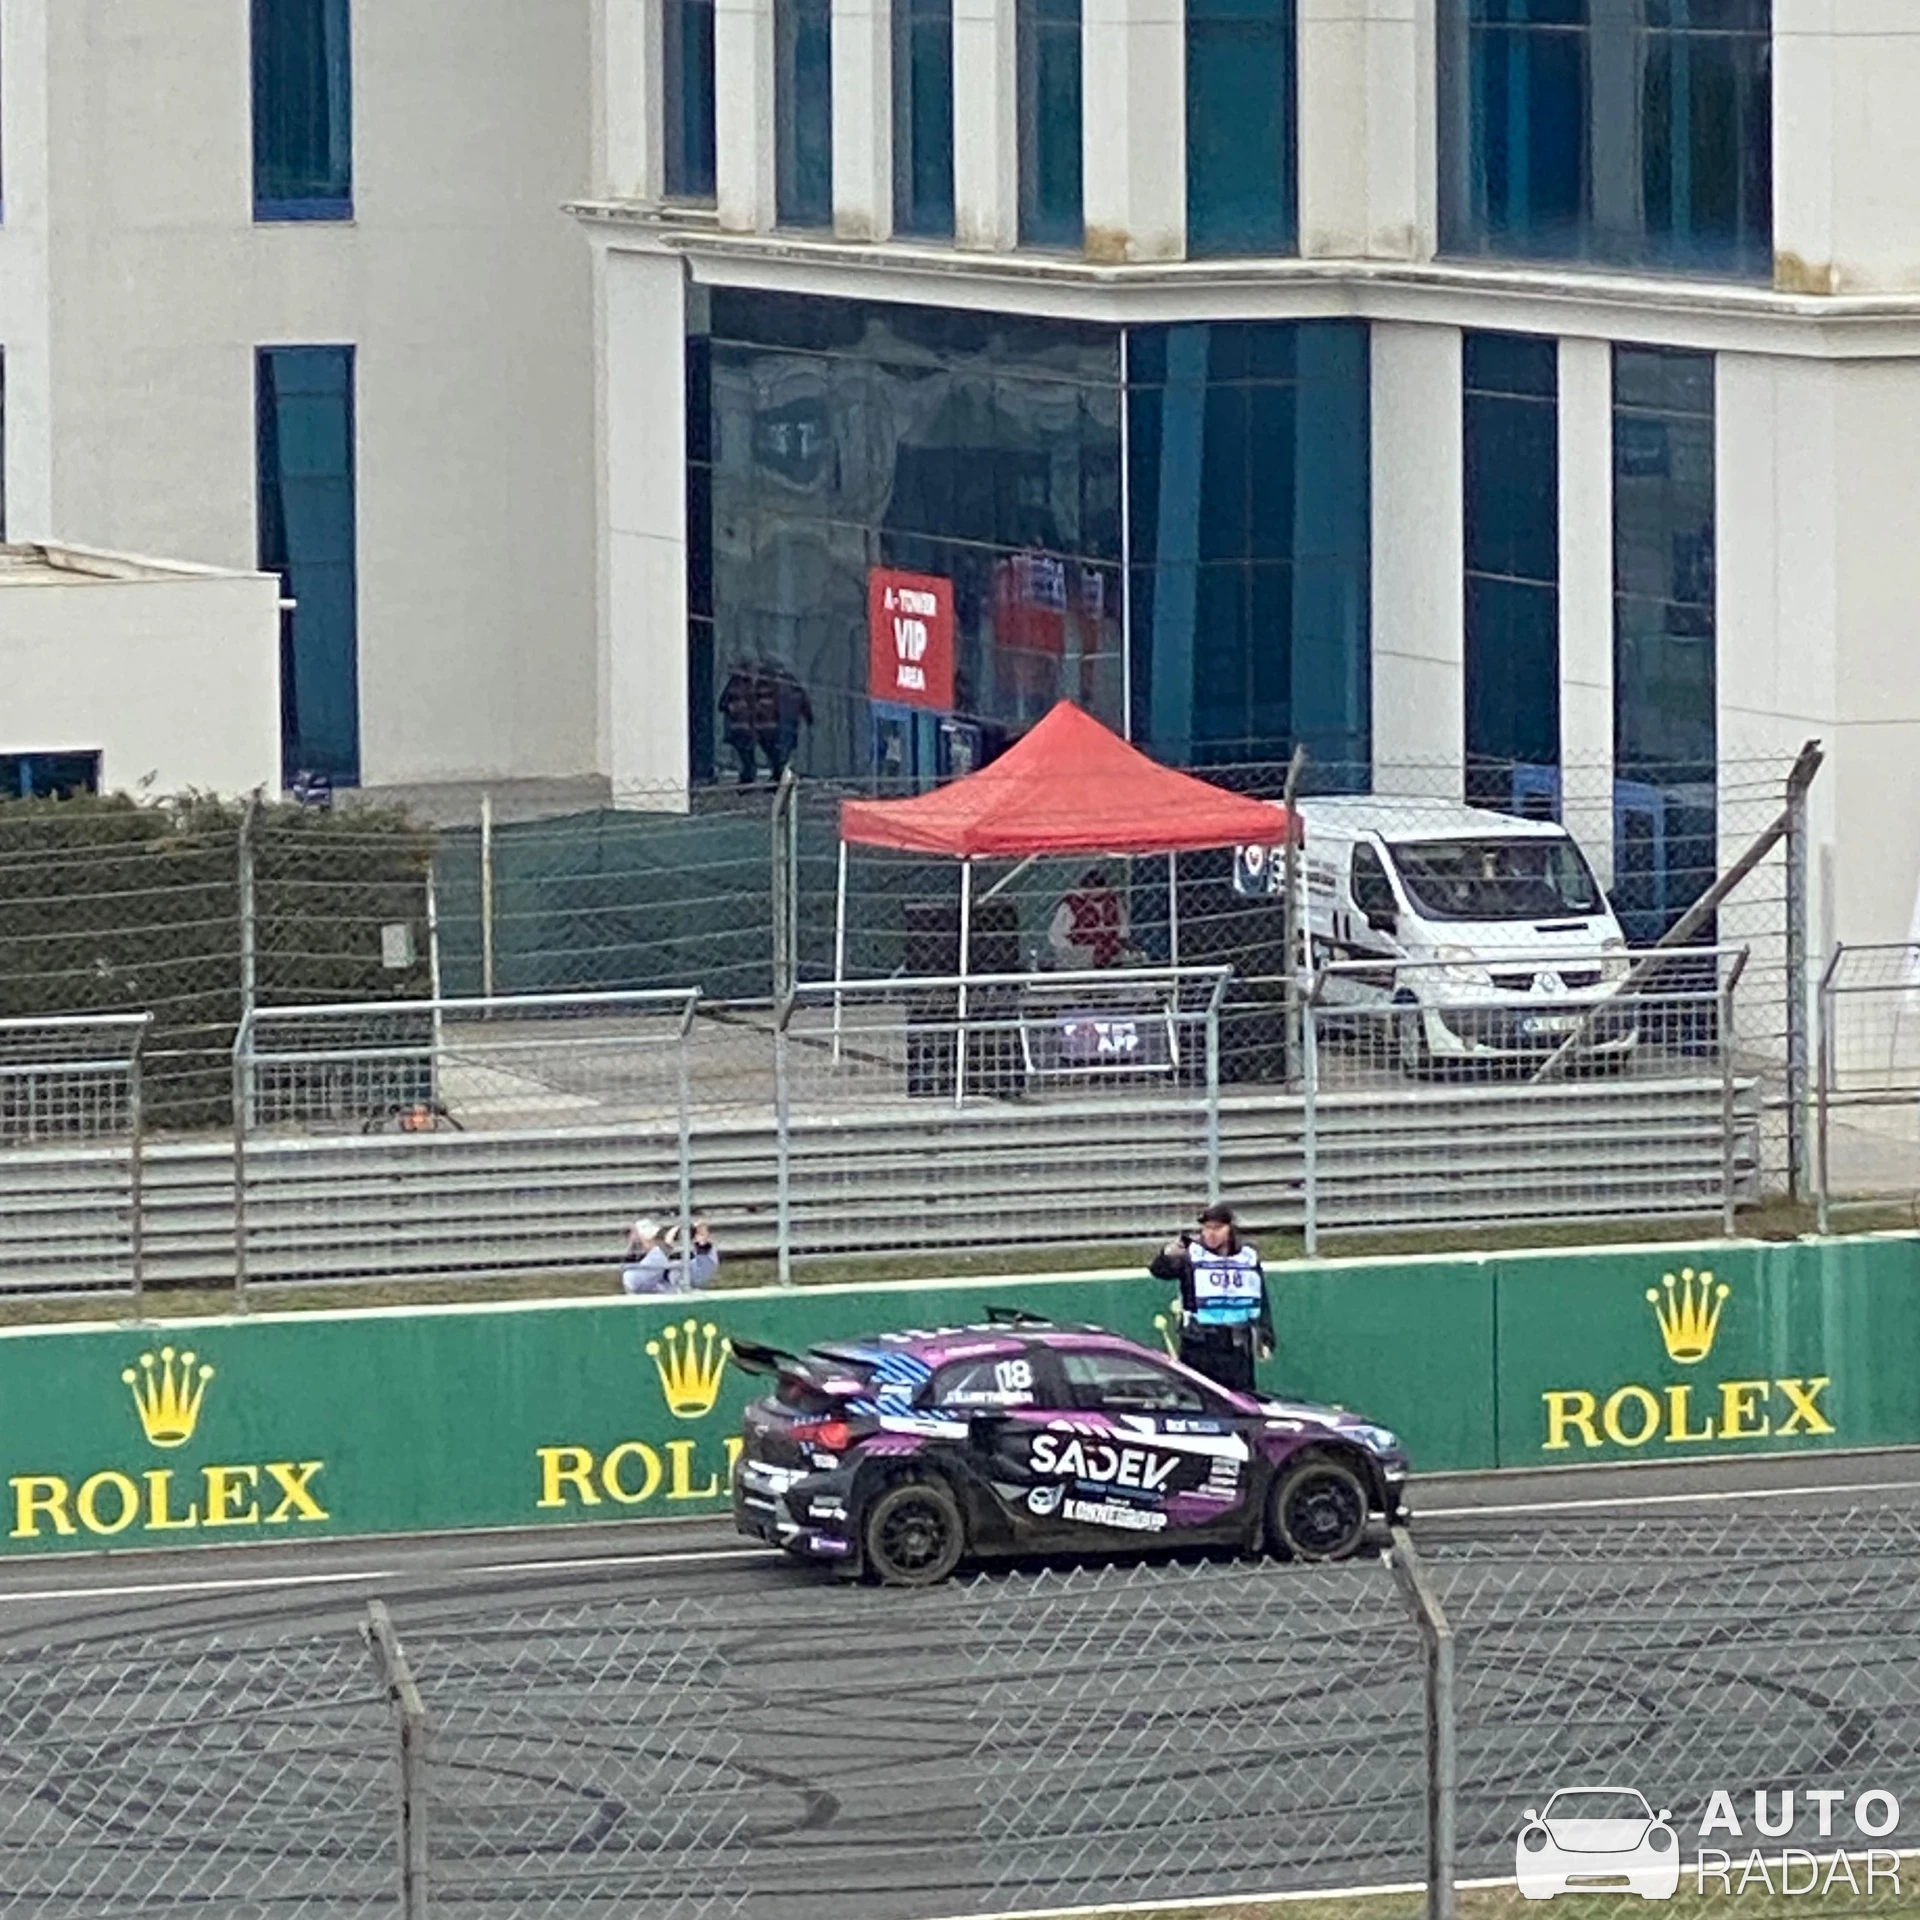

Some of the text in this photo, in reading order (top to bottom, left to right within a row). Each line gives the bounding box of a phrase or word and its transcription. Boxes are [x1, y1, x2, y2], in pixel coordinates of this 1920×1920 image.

[894, 617, 927, 661] VIP
[1004, 1360, 1032, 1389] 18
[1541, 1377, 1836, 1449] ROLEX
[8, 1461, 330, 1538] ROLEX
